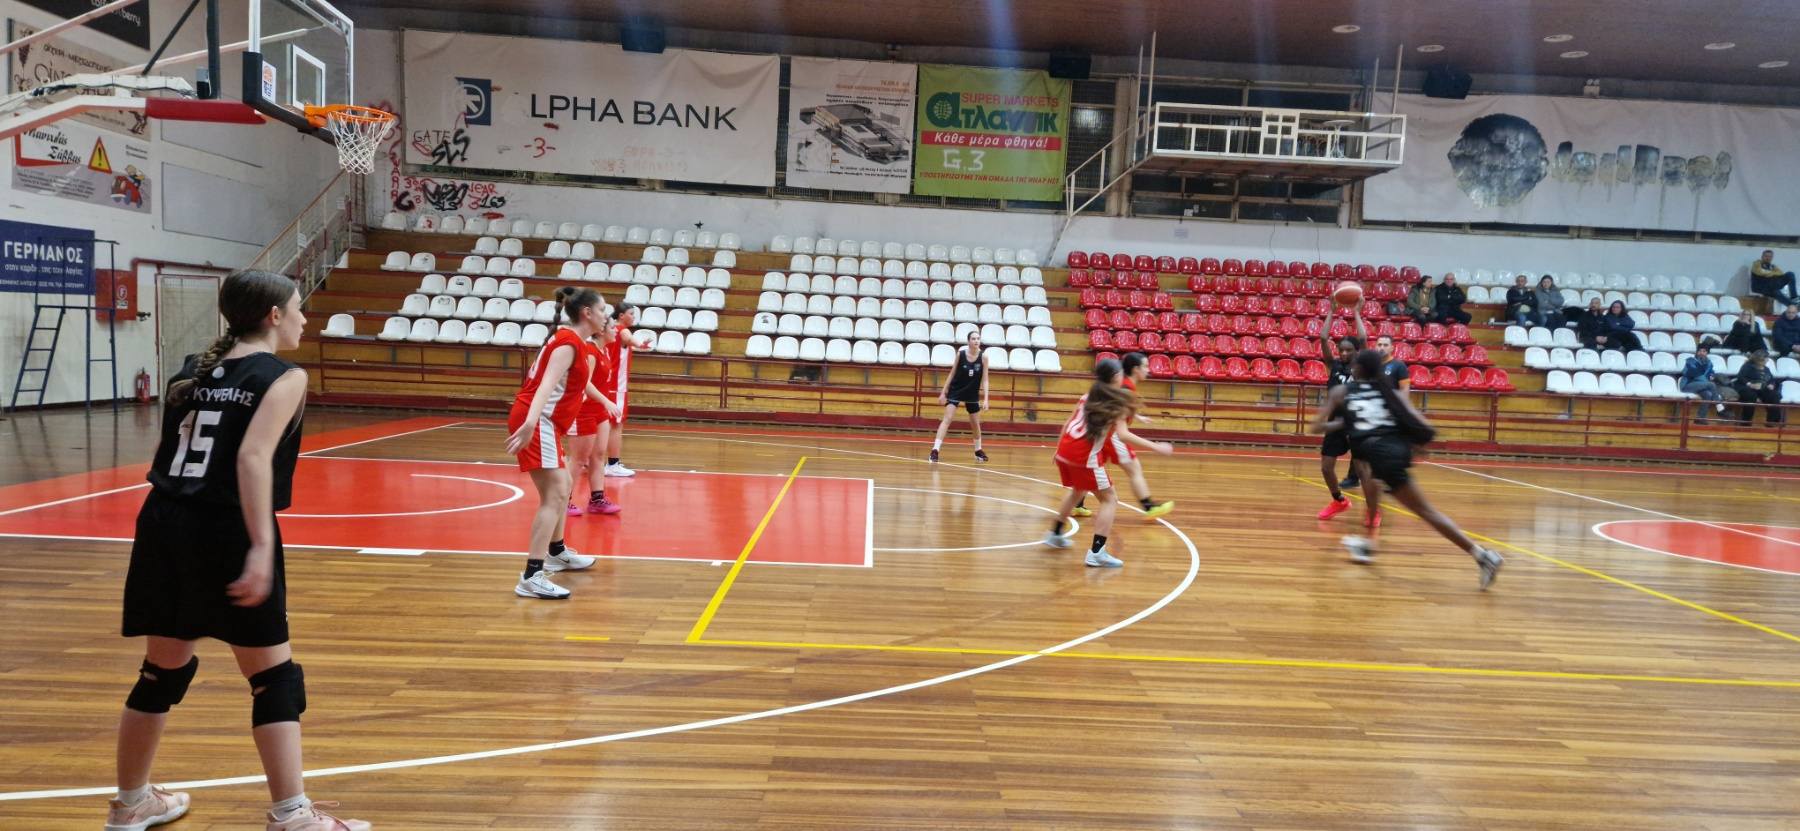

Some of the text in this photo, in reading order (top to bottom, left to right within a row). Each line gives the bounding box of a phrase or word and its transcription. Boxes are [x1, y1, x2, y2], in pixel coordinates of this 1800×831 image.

[961, 92, 1059, 107] SUPER MARKETS
[633, 100, 738, 131] BANK
[934, 132, 1048, 150] Κάθε μέρα φθηνά!
[4, 240, 83, 264] ΓΕΡΜΑΝΟΣ
[168, 410, 223, 478] 15
